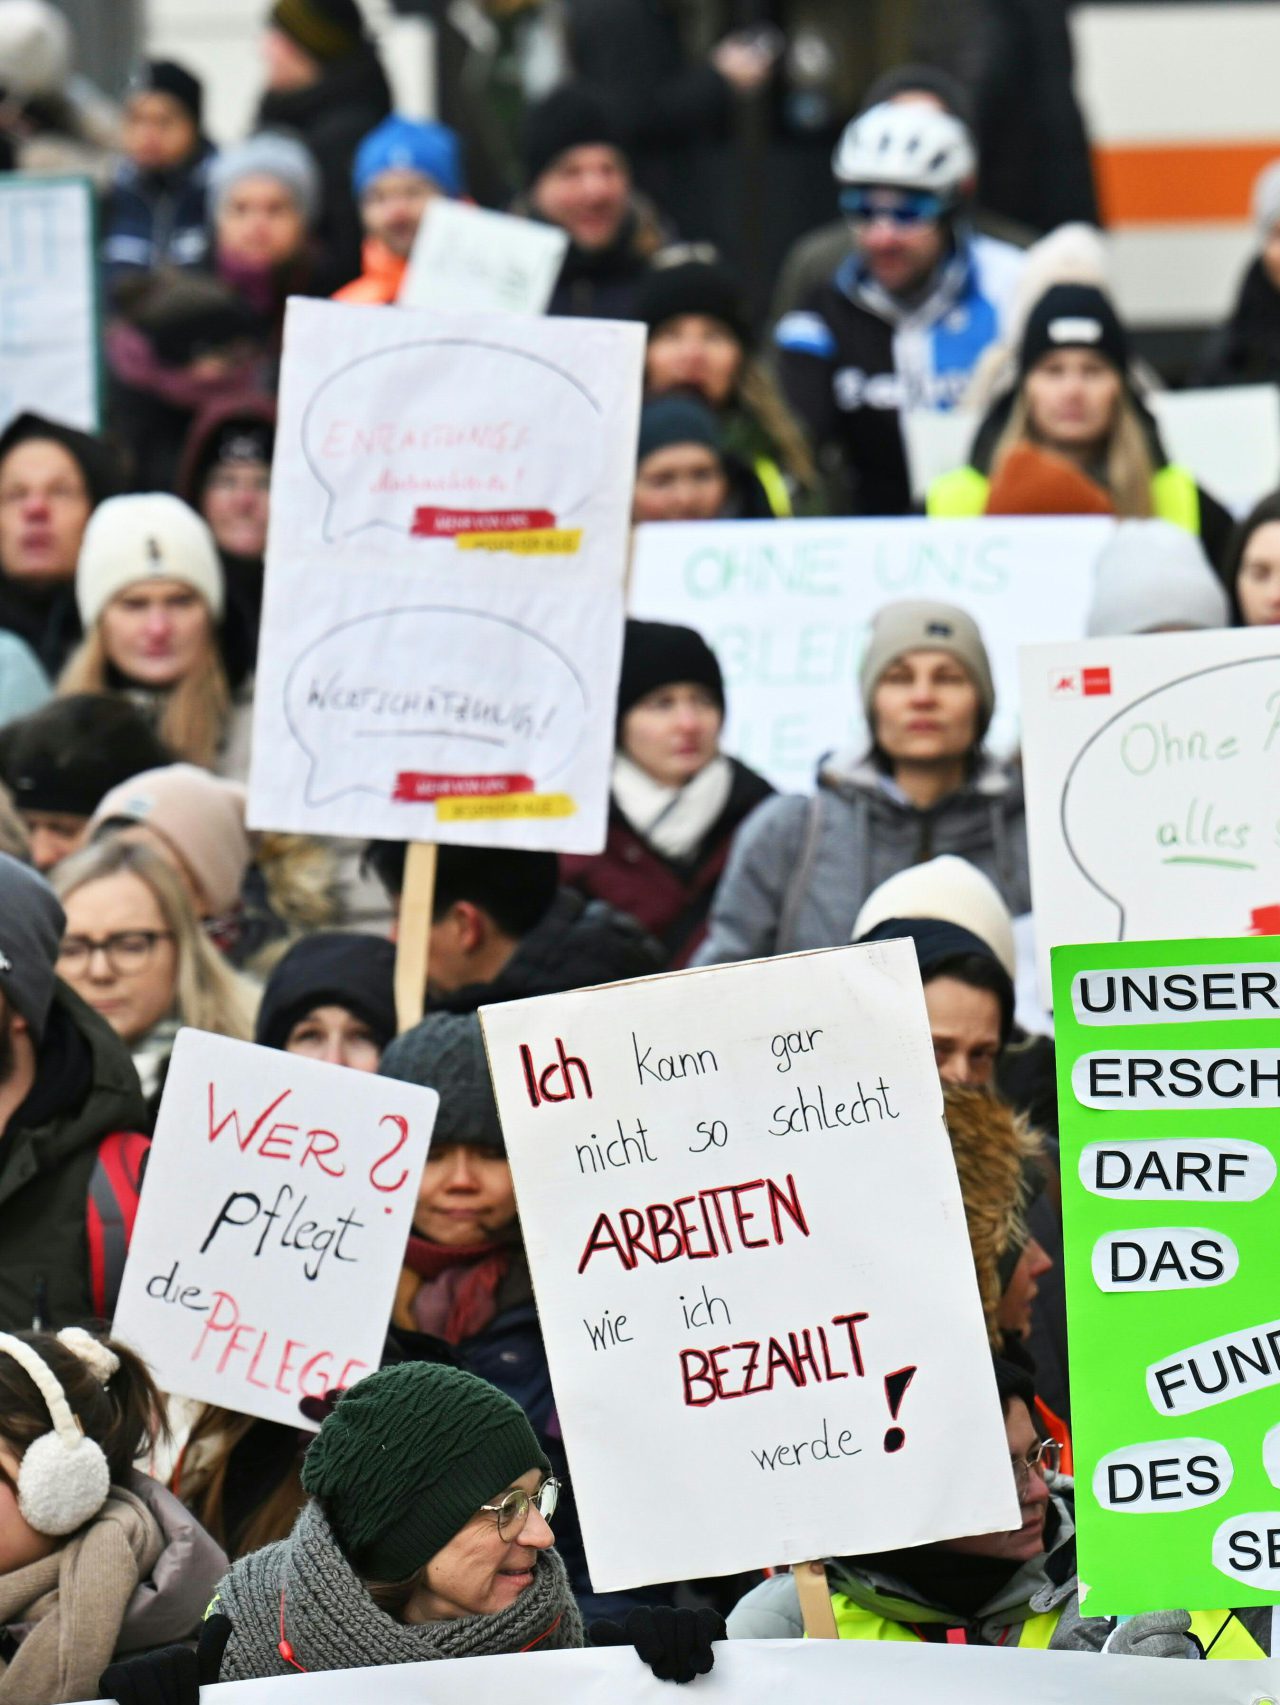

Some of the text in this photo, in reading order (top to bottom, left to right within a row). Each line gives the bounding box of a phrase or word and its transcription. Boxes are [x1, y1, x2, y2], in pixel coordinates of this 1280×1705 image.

[874, 534, 1013, 598] UNS
[1121, 723, 1240, 777] Ohne
[1157, 797, 1249, 850] alles
[519, 1026, 823, 1107] Ich kann gar
[575, 1077, 900, 1175] nicht so schlecht
[1095, 1150, 1249, 1192] DARF
[577, 1173, 810, 1275] ARBEITEN
[146, 1262, 208, 1310] die
[1110, 1240, 1224, 1283] DAS
[583, 1285, 731, 1352] wie ich
[679, 1312, 870, 1408] BEZAHLT
[751, 1418, 863, 1471] werde
[1107, 1455, 1220, 1505] DES
